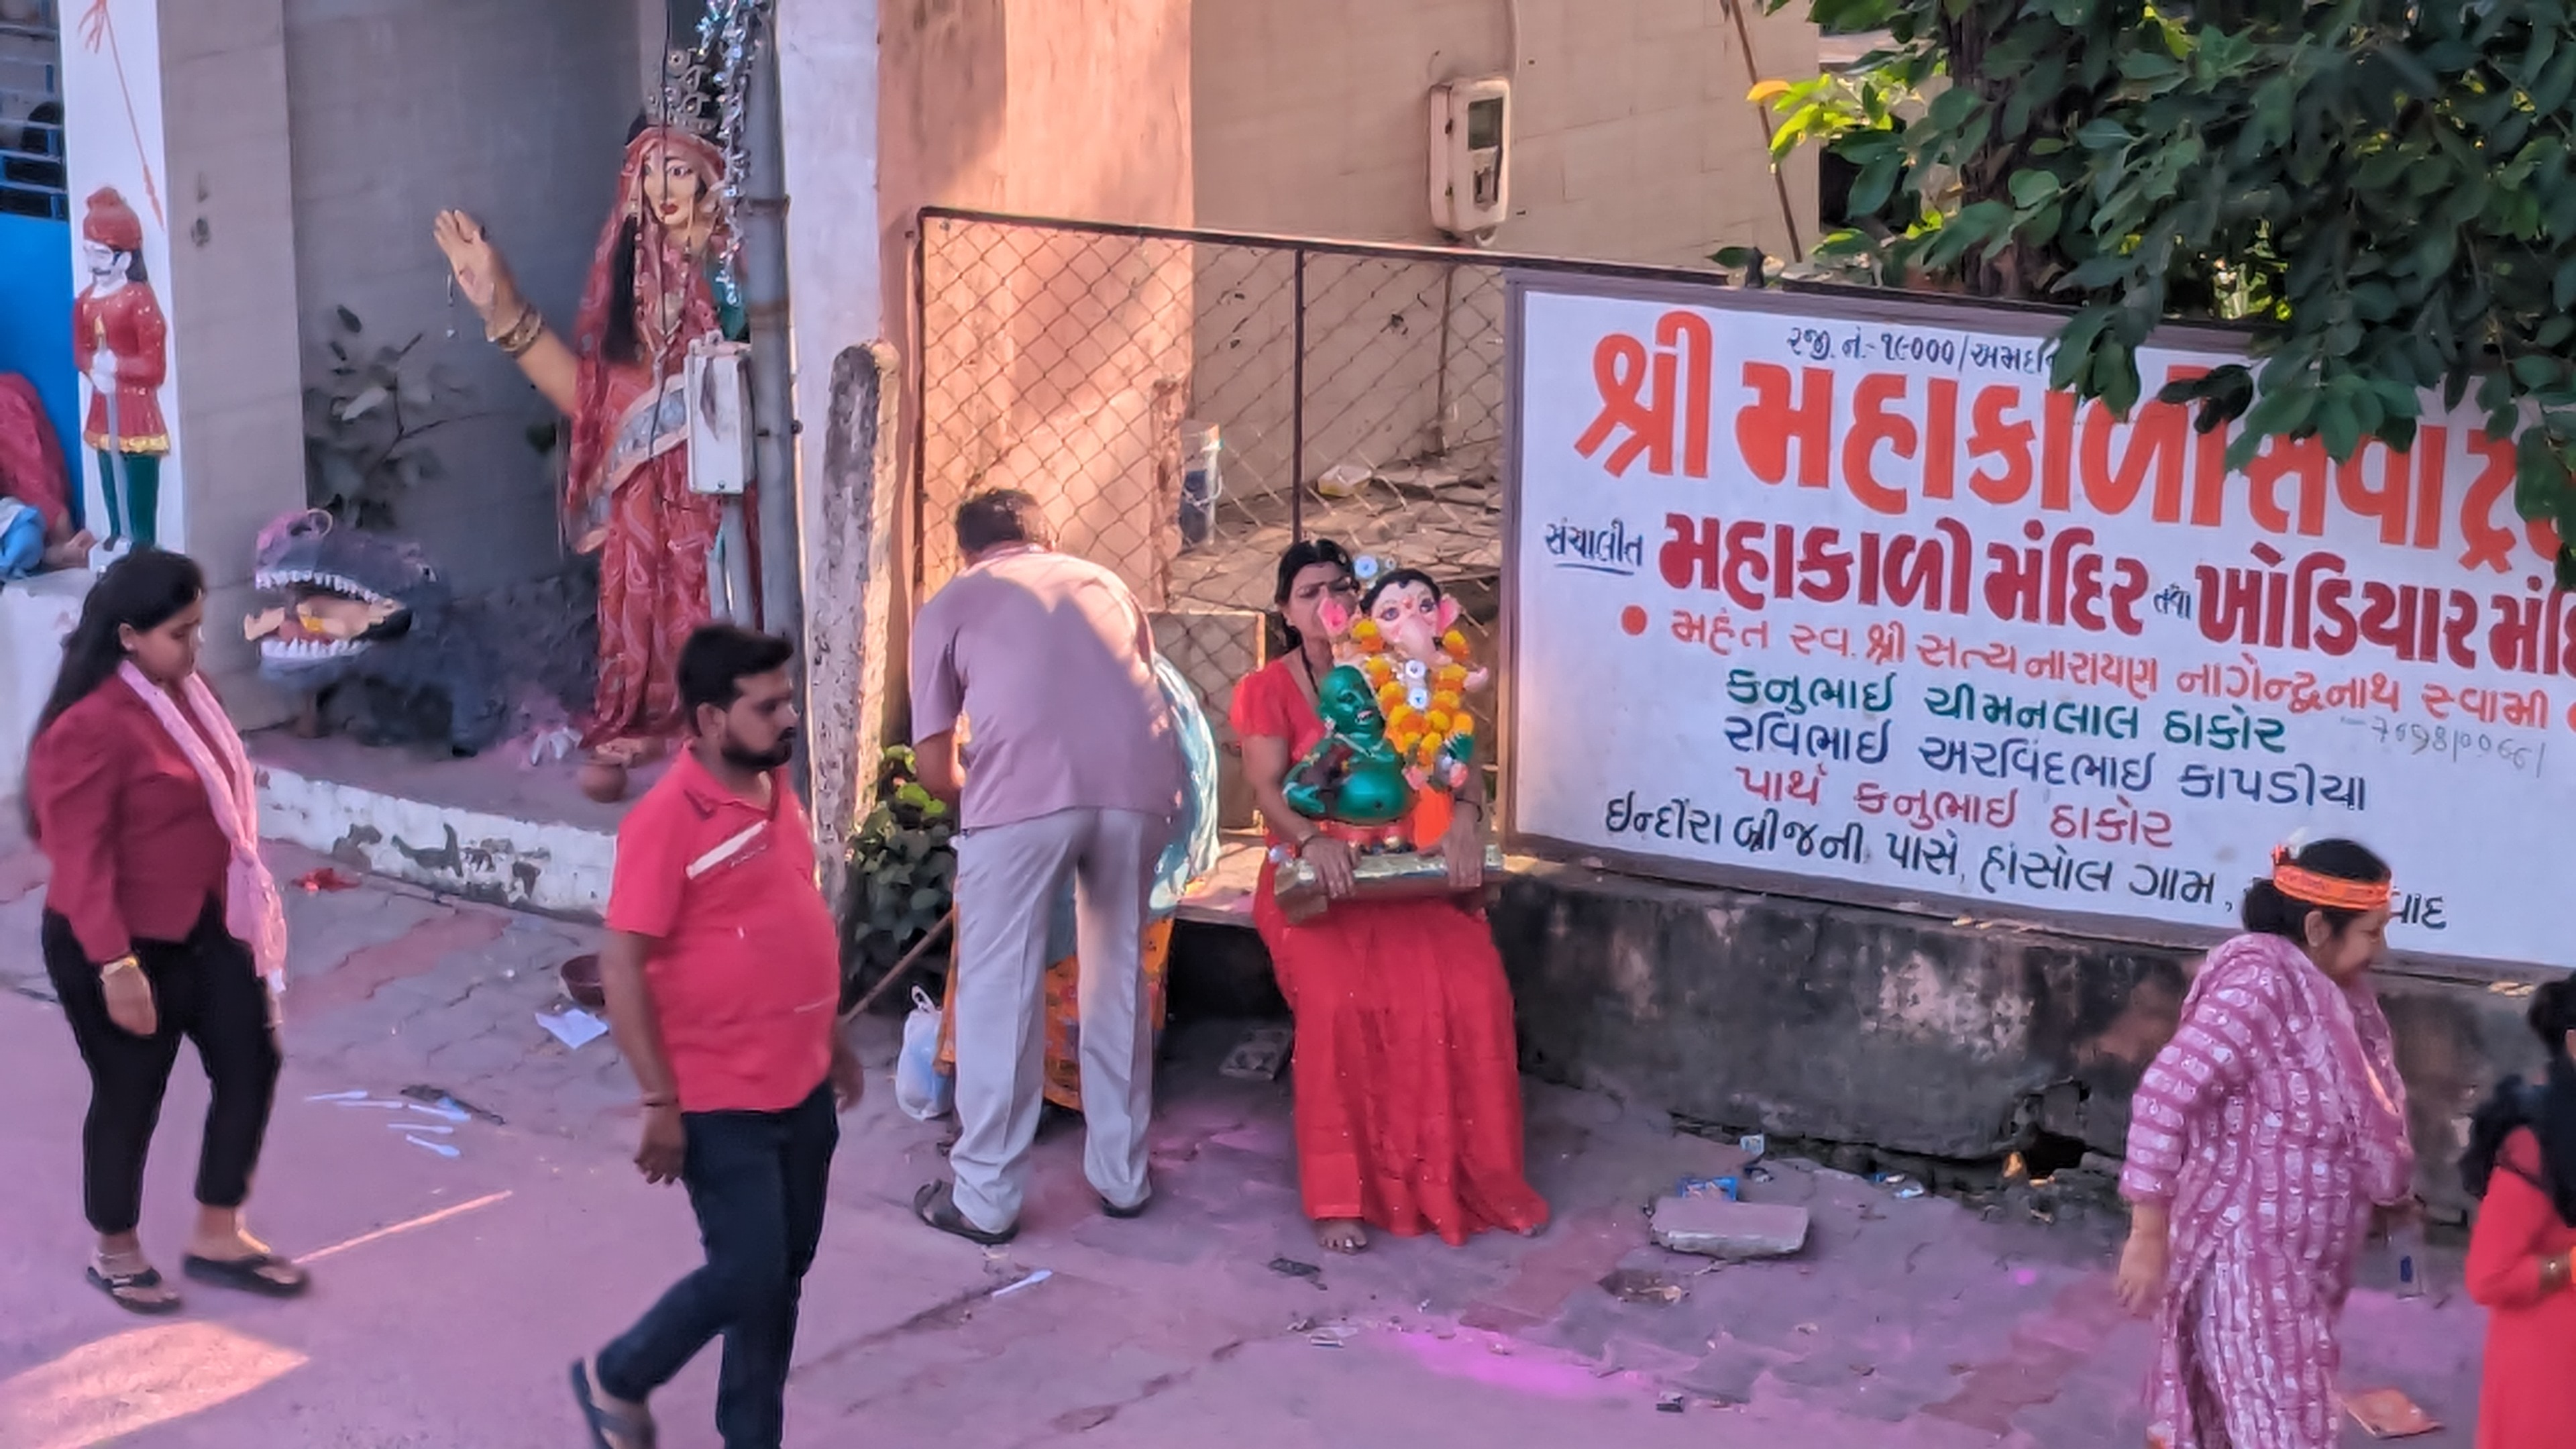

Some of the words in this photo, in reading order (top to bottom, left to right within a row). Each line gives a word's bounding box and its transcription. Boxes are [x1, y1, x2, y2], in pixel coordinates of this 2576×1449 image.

[1574, 311, 1713, 478] શ્રી
[1659, 513, 1972, 614] મહાકાળી
[1984, 519, 2149, 635] મંદિર
[2195, 541, 2479, 669] ખોડિયાર
[1671, 607, 1768, 655] મહંત
[1866, 621, 1905, 665] શ્રી
[2421, 683, 2549, 730] સ્વામી
[1726, 669, 1897, 715] કનુભાઈ
[1923, 683, 2139, 739] ચીમનલાલ
[2163, 703, 2286, 753] ઠાકોર
[1724, 711, 1892, 764] રવિભાઈ
[1919, 737, 2156, 792] અરવિંદભાઈ
[2178, 762, 2365, 810] કાપડીયા
[1854, 782, 2019, 831] કનુભાઈ
[2049, 794, 2173, 848] ઠાકોર
